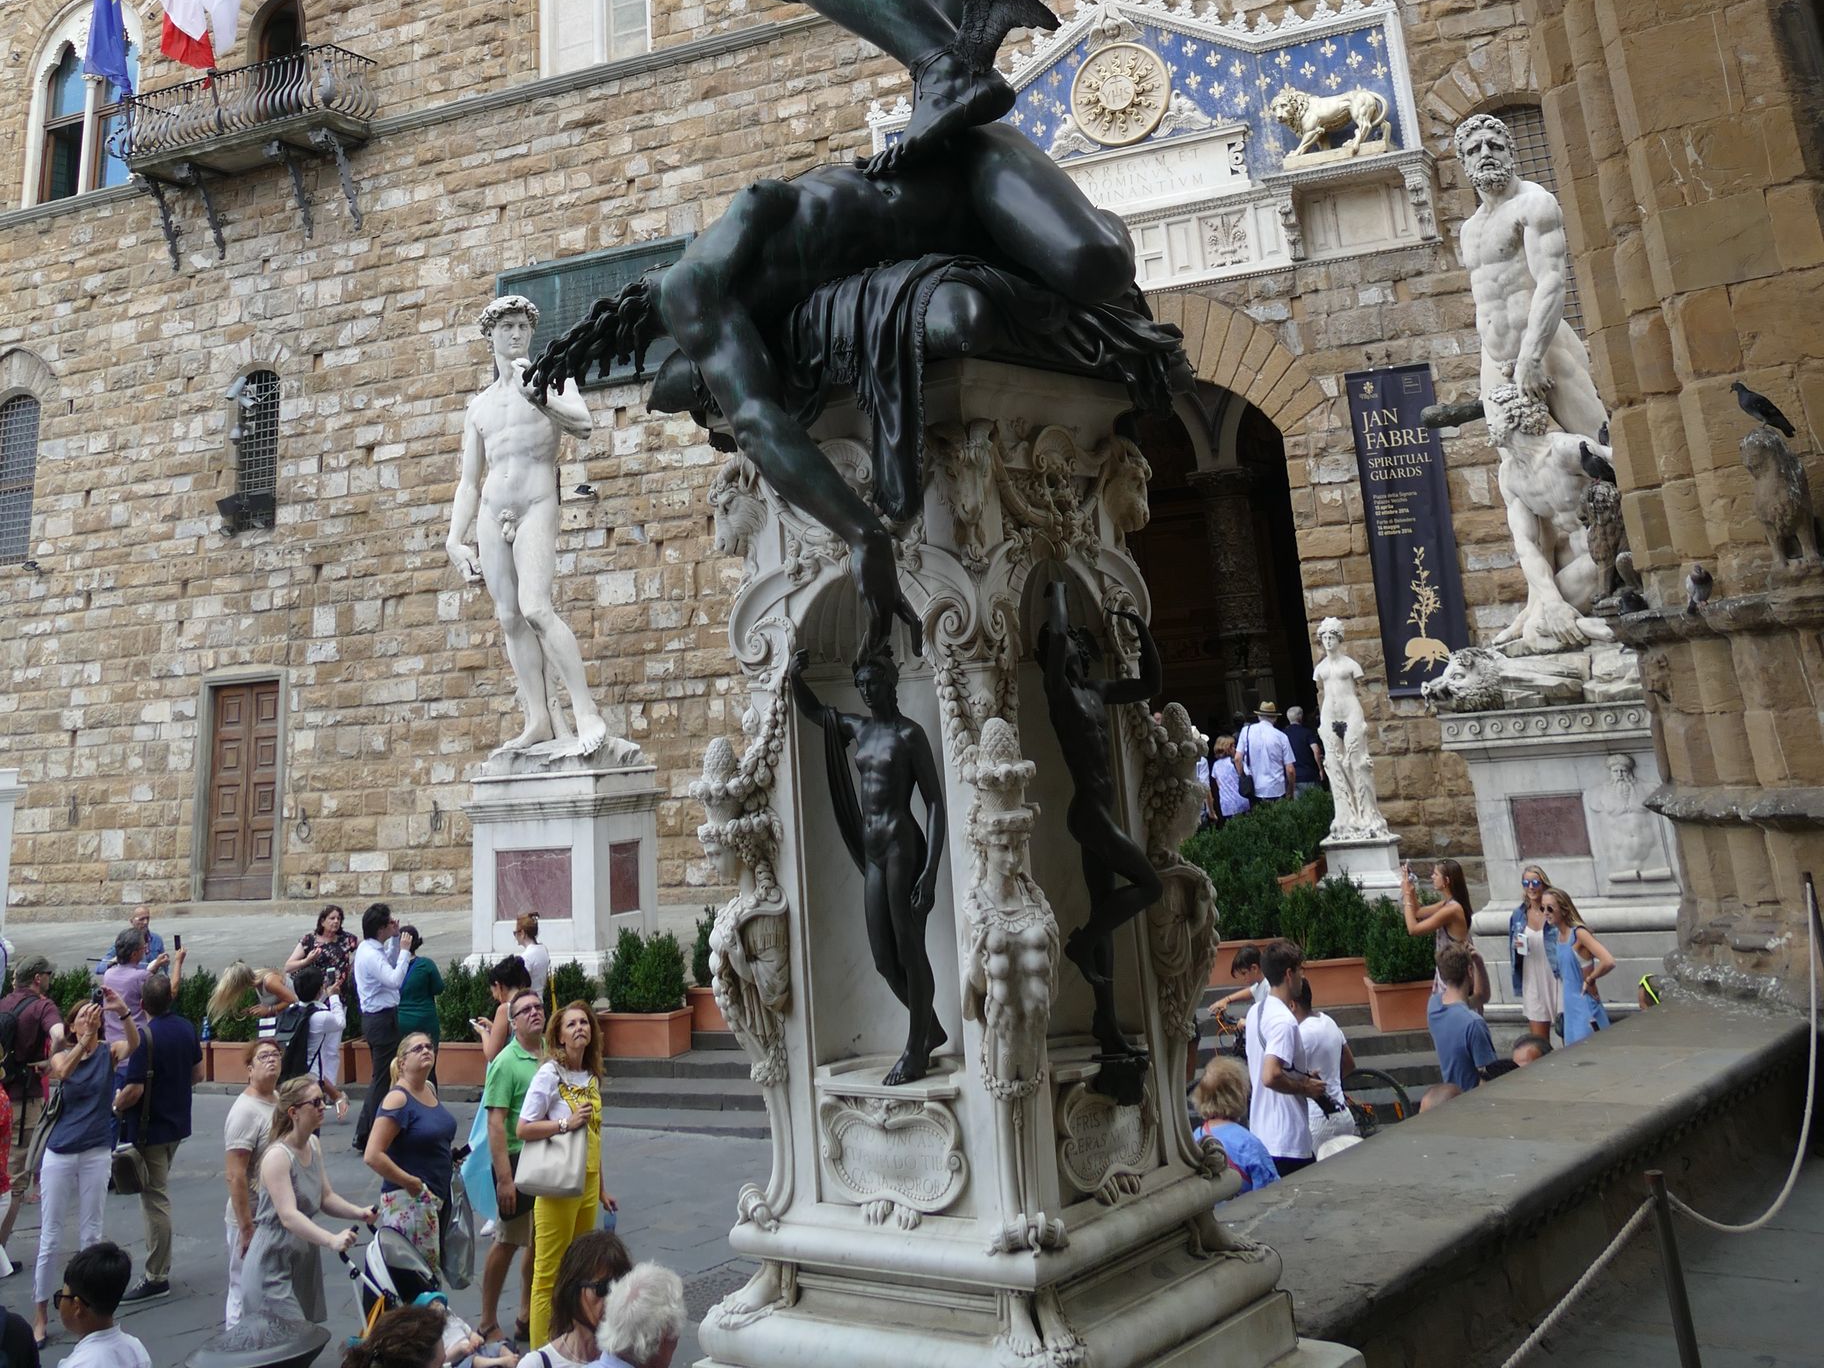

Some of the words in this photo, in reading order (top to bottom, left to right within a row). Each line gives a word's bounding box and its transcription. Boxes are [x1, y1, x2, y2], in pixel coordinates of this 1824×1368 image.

[1102, 154, 1167, 178] REGVM
[1178, 148, 1201, 162] ET
[1087, 165, 1176, 193] DOMINVS
[1093, 172, 1205, 204] MINANTIVM
[1361, 407, 1399, 434] JAN
[1365, 427, 1431, 450] FABRE
[1367, 452, 1433, 469] SPIRITUAL
[1370, 465, 1423, 482] GUARDS
